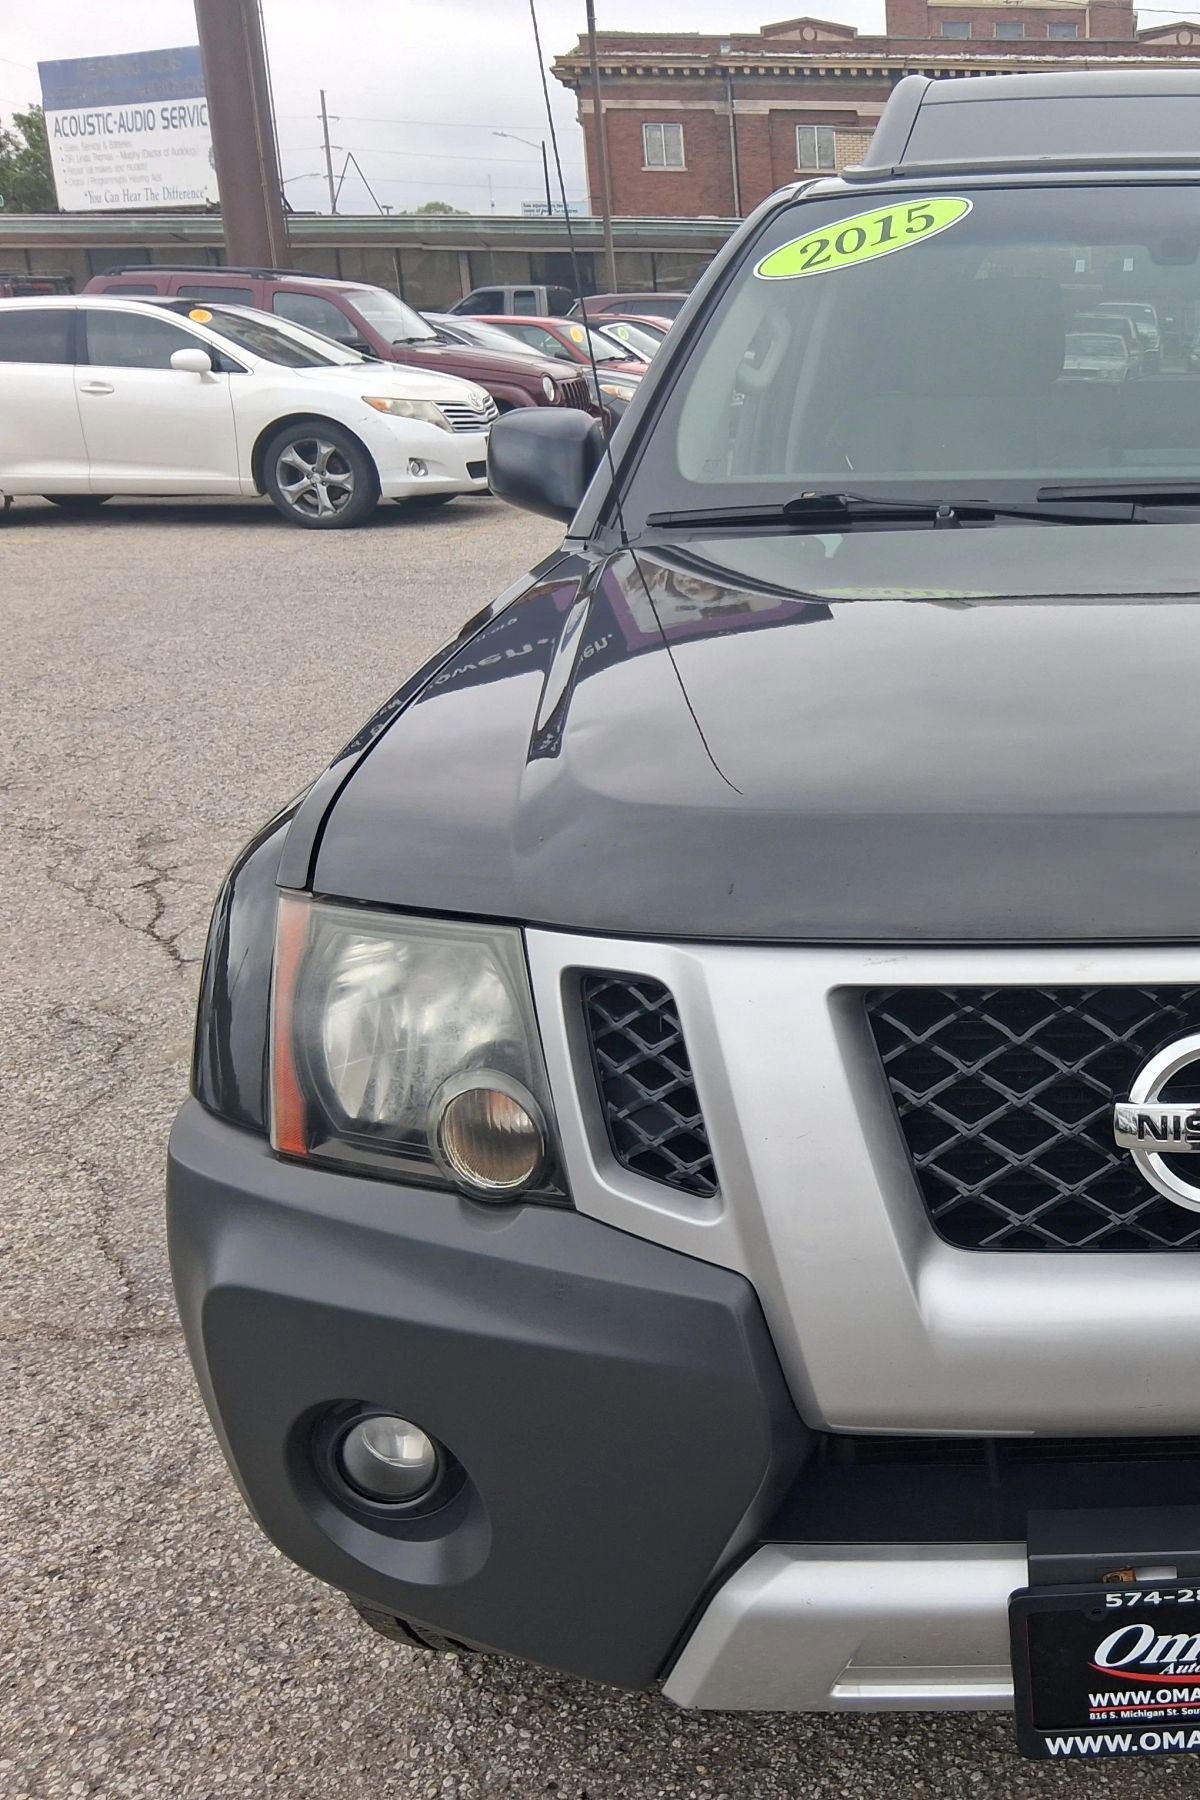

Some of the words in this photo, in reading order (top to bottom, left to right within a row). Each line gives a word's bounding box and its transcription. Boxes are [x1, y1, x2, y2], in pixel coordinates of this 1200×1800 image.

[161, 104, 208, 130] SERVIC
[104, 189, 120, 203] Can
[122, 187, 142, 202] Hear
[143, 186, 160, 201] The
[799, 204, 936, 269] 2015
[1089, 1711, 1108, 1721] 816
[1109, 1710, 1119, 1720] S.
[1120, 1707, 1165, 1719] Michigan
[1166, 1708, 1180, 1716] St.
